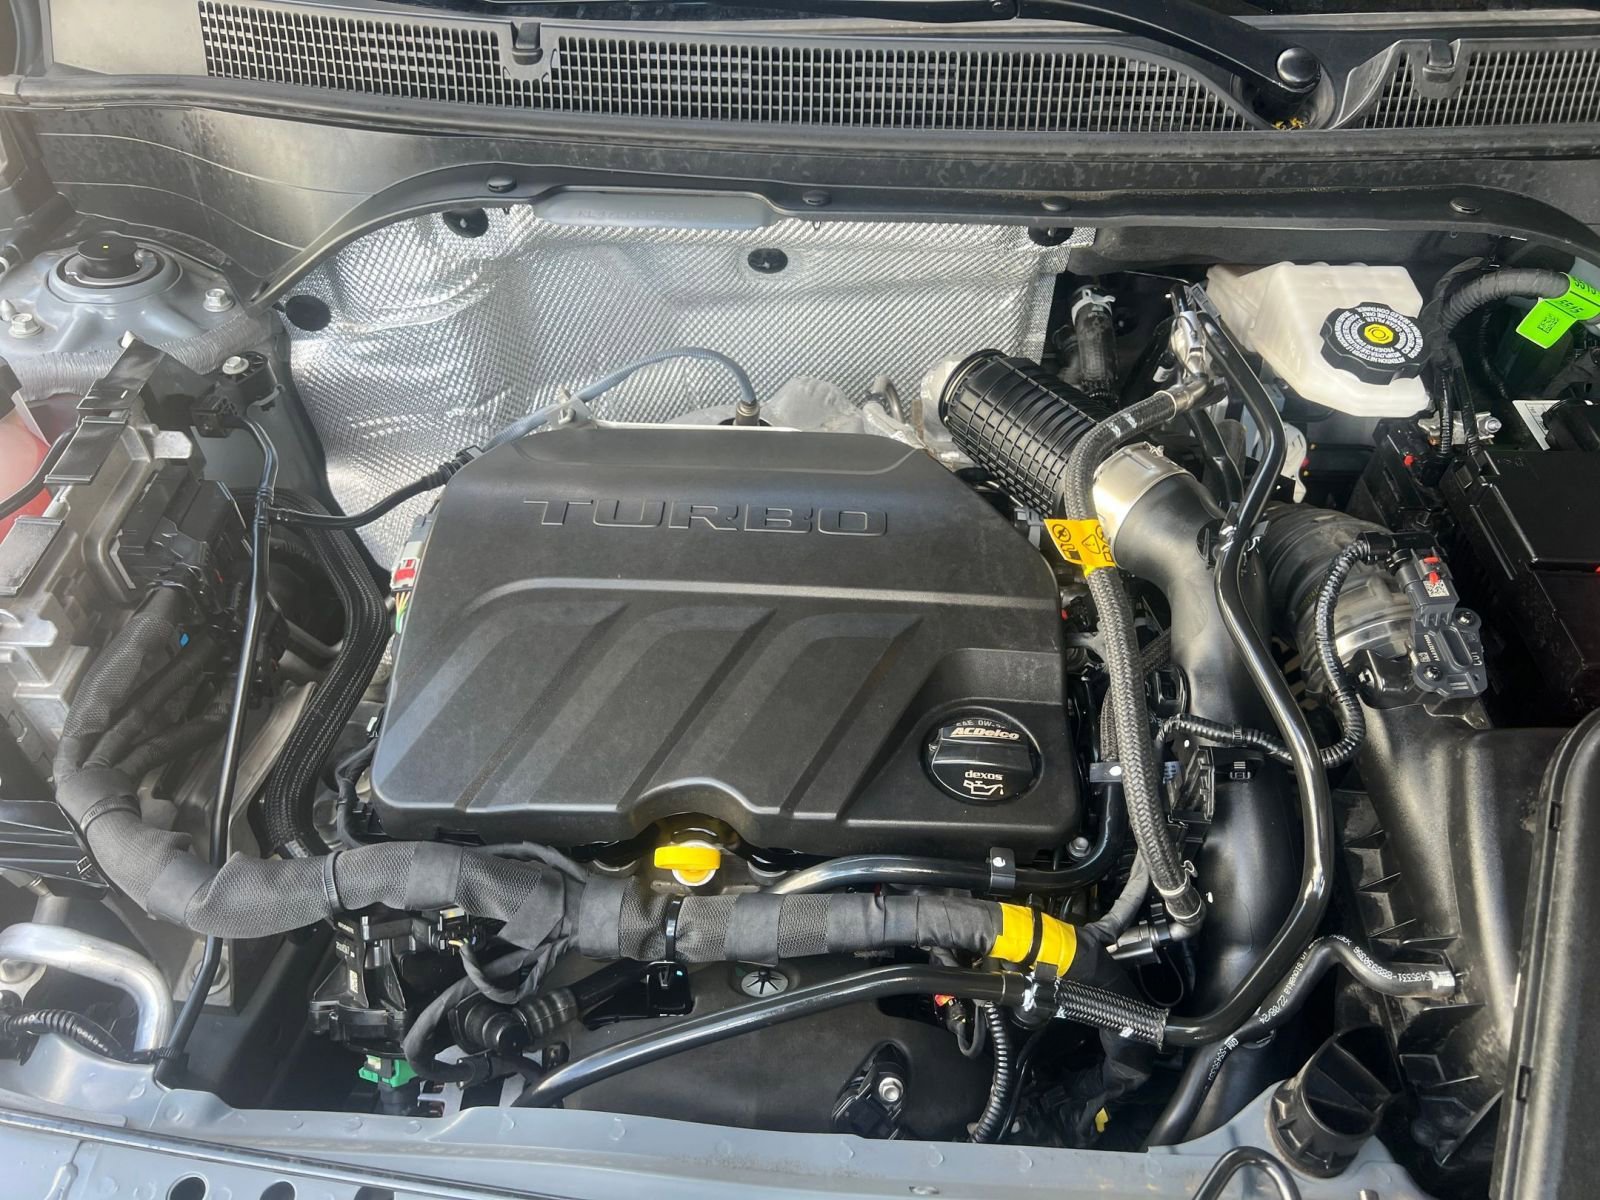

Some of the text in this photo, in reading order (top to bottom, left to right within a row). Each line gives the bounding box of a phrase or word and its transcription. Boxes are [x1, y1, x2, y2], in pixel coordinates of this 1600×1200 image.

[523, 498, 889, 537] TURBO
[950, 726, 1020, 740] ACDelco
[964, 769, 1004, 781] dexos
